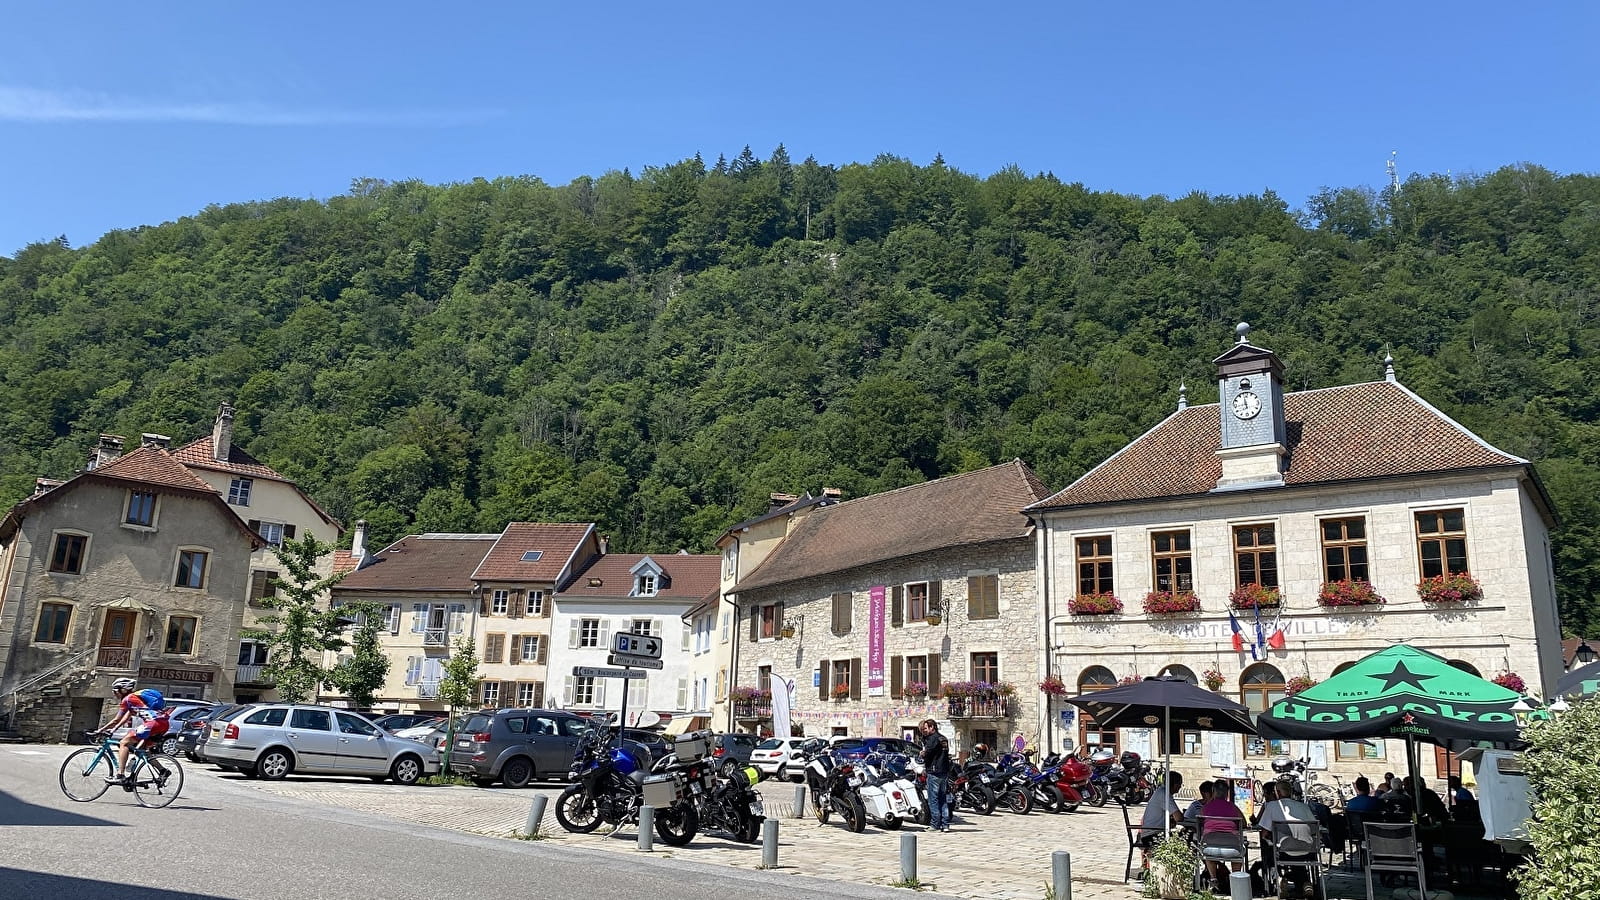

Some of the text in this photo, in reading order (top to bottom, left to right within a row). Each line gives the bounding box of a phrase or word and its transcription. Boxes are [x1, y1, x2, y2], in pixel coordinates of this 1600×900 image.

[1281, 621, 1340, 636] VILLE
[620, 638, 627, 649] P
[141, 668, 208, 681] CHAUSSURES
[1390, 725, 1430, 735] Heineken
